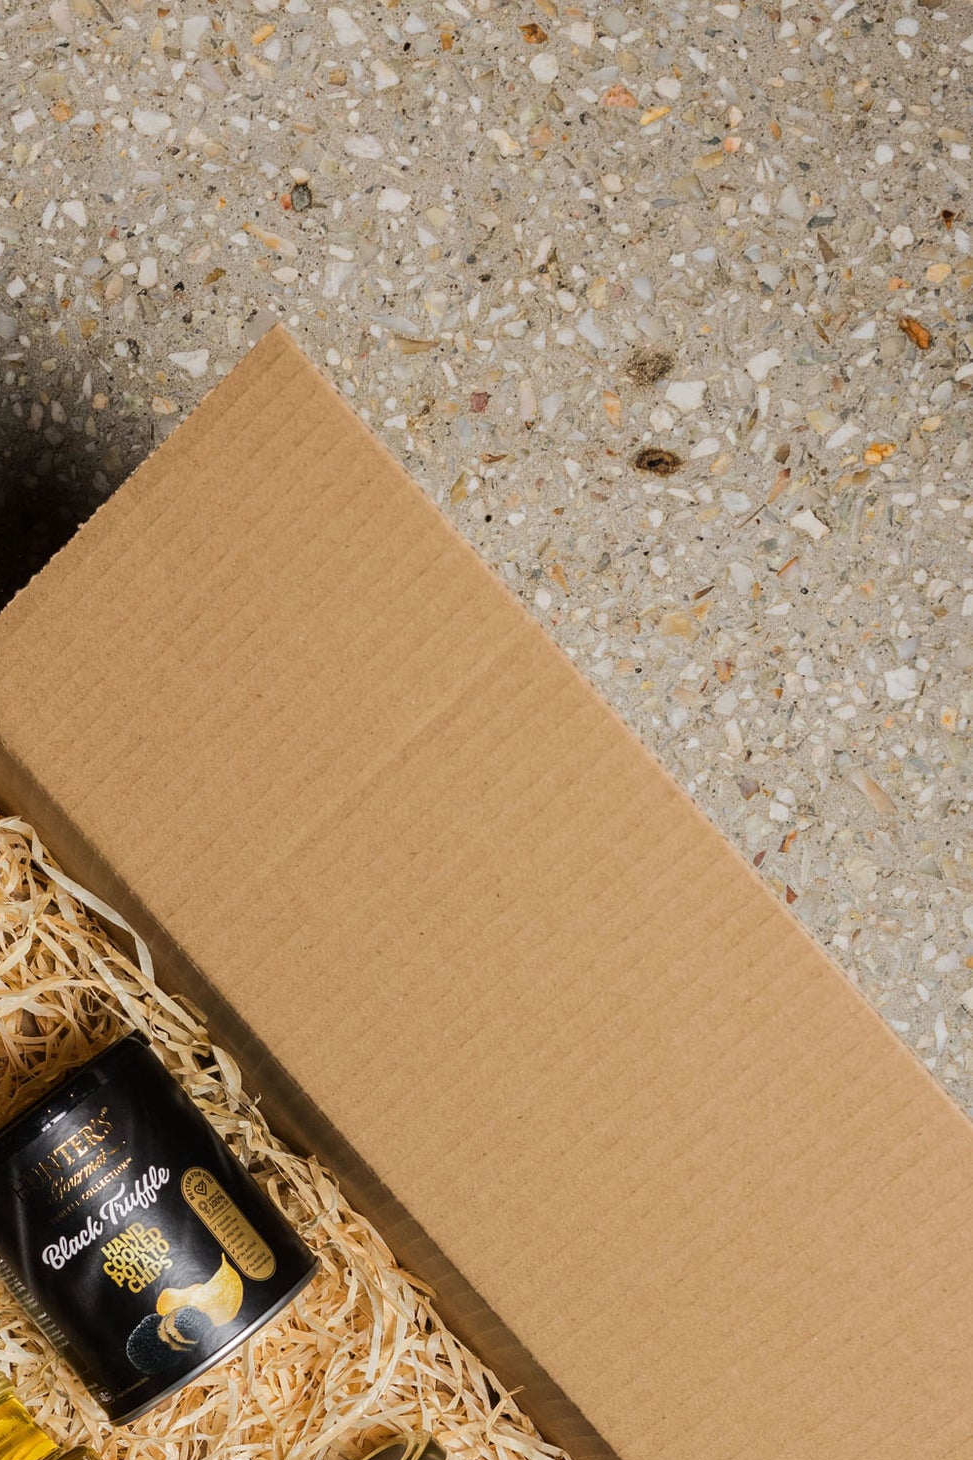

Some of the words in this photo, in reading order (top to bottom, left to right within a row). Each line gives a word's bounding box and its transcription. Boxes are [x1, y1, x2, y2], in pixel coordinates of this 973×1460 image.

[202, 1172, 214, 1184] YOU
[42, 1216, 103, 1270] Black
[99, 1165, 170, 1226] Truffle
[101, 1222, 145, 1260] HAND
[103, 1226, 162, 1276] COOKED
[111, 1238, 170, 1288] POTATO
[128, 1254, 173, 1293] CHIPS
